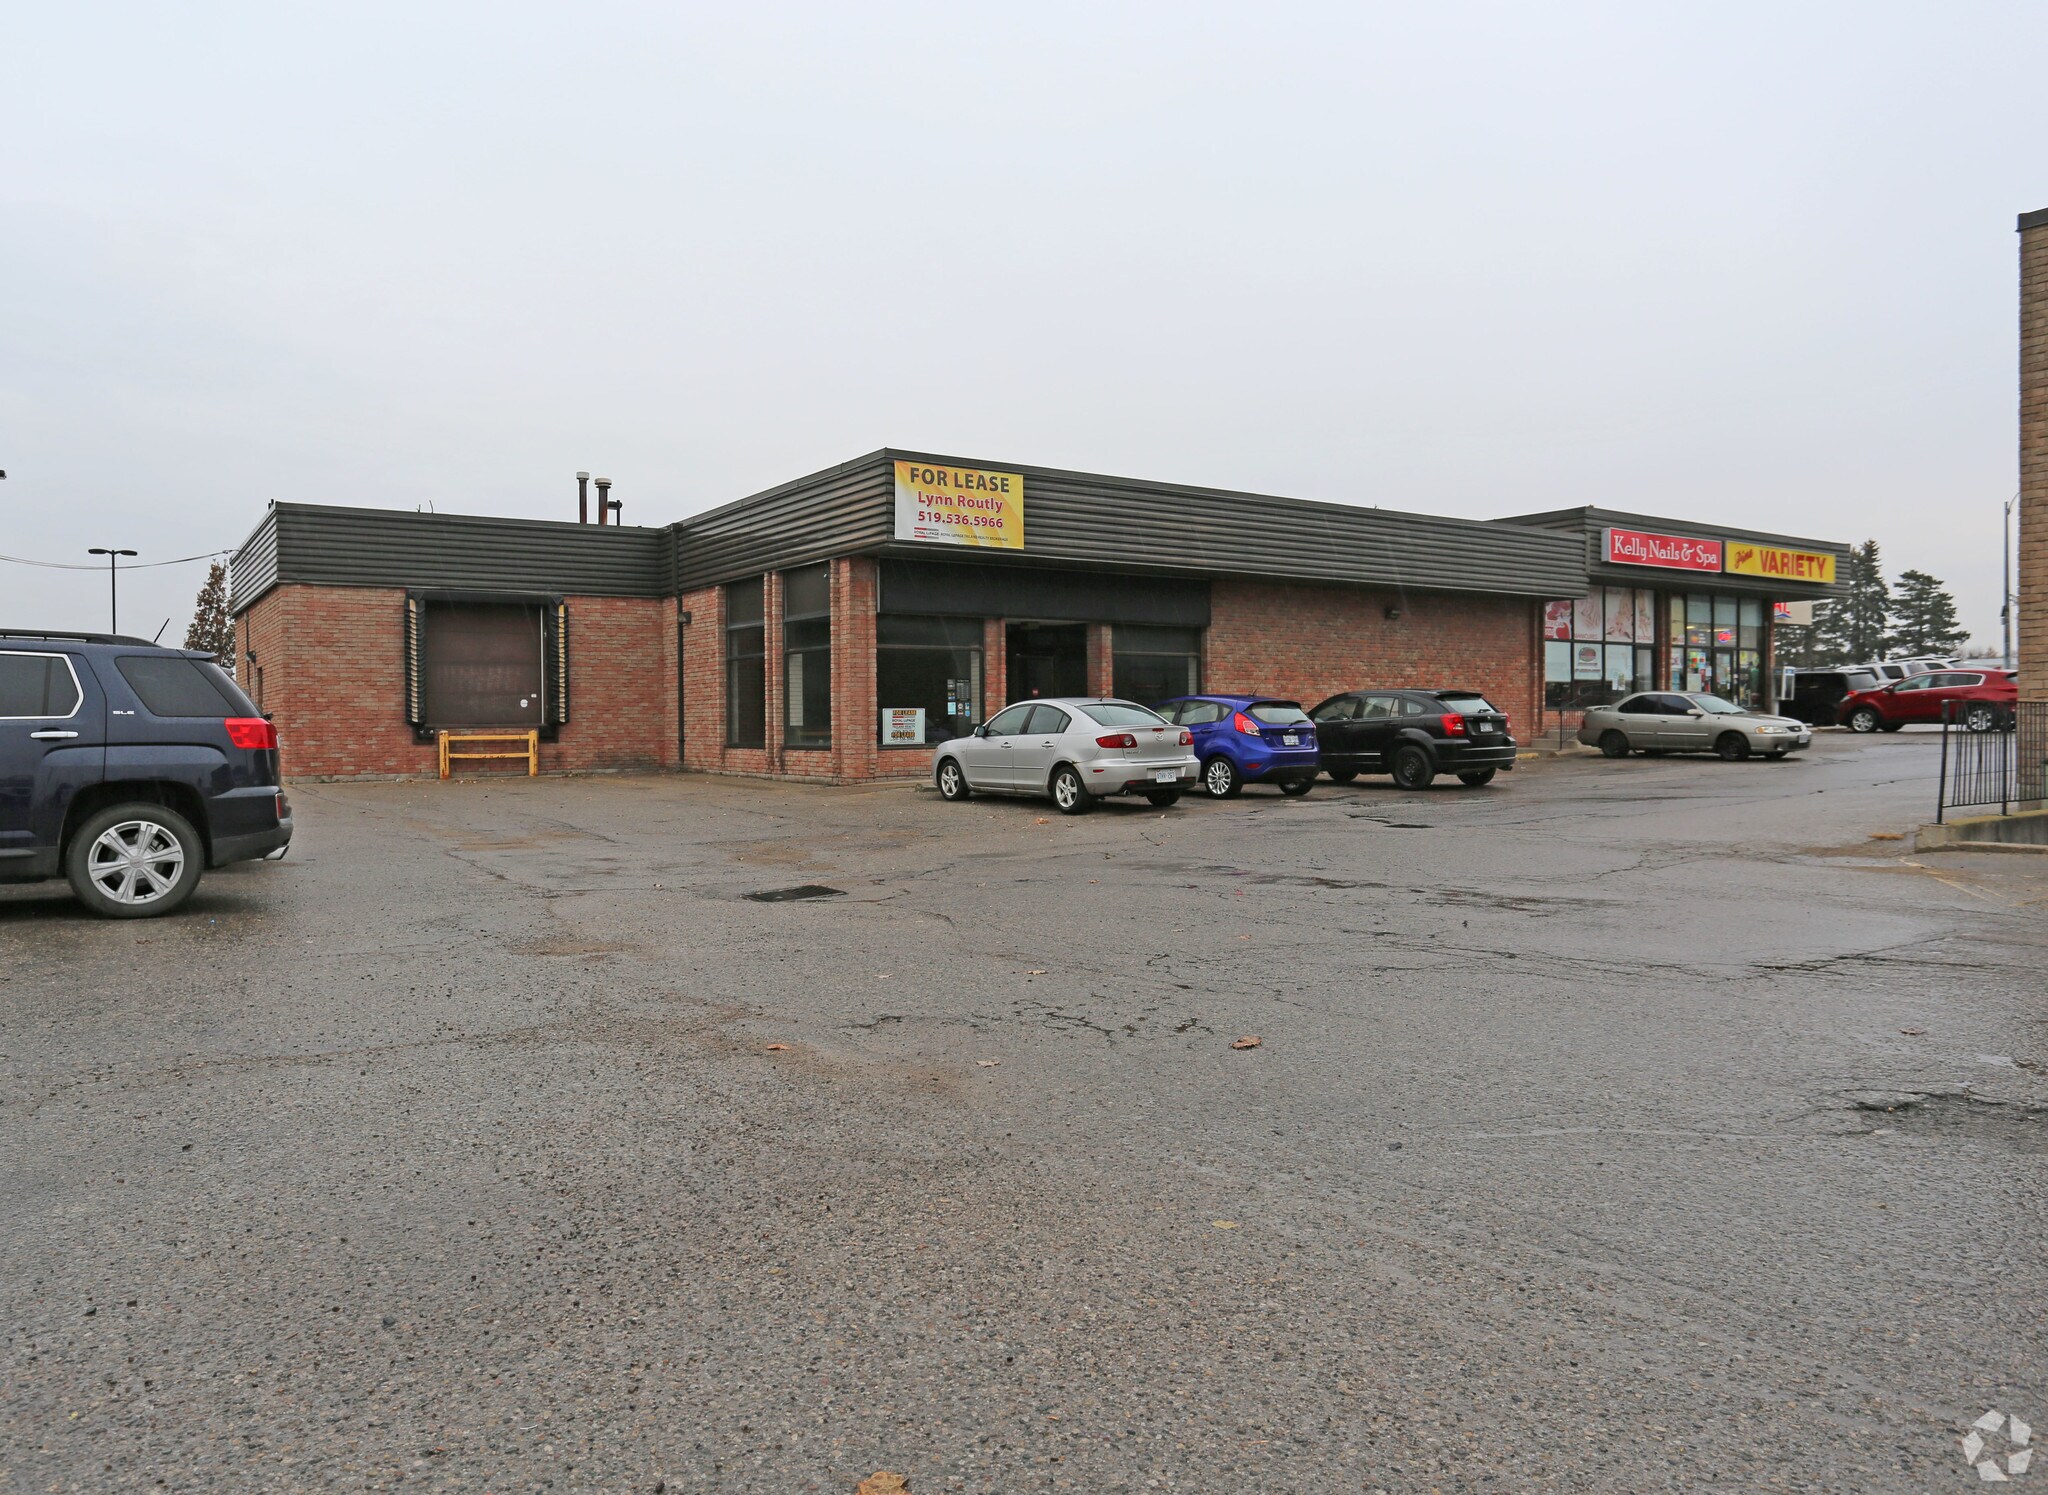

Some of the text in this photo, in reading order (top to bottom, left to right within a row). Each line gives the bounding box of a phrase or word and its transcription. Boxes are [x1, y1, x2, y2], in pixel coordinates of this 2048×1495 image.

[910, 467, 1010, 493] FOR LEASE
[918, 491, 1003, 513] Lynn Routly
[918, 511, 1003, 528] 519.536.5966
[1613, 535, 1717, 567] Kelly Nails & Spa
[1760, 550, 1827, 578] VARIETY
